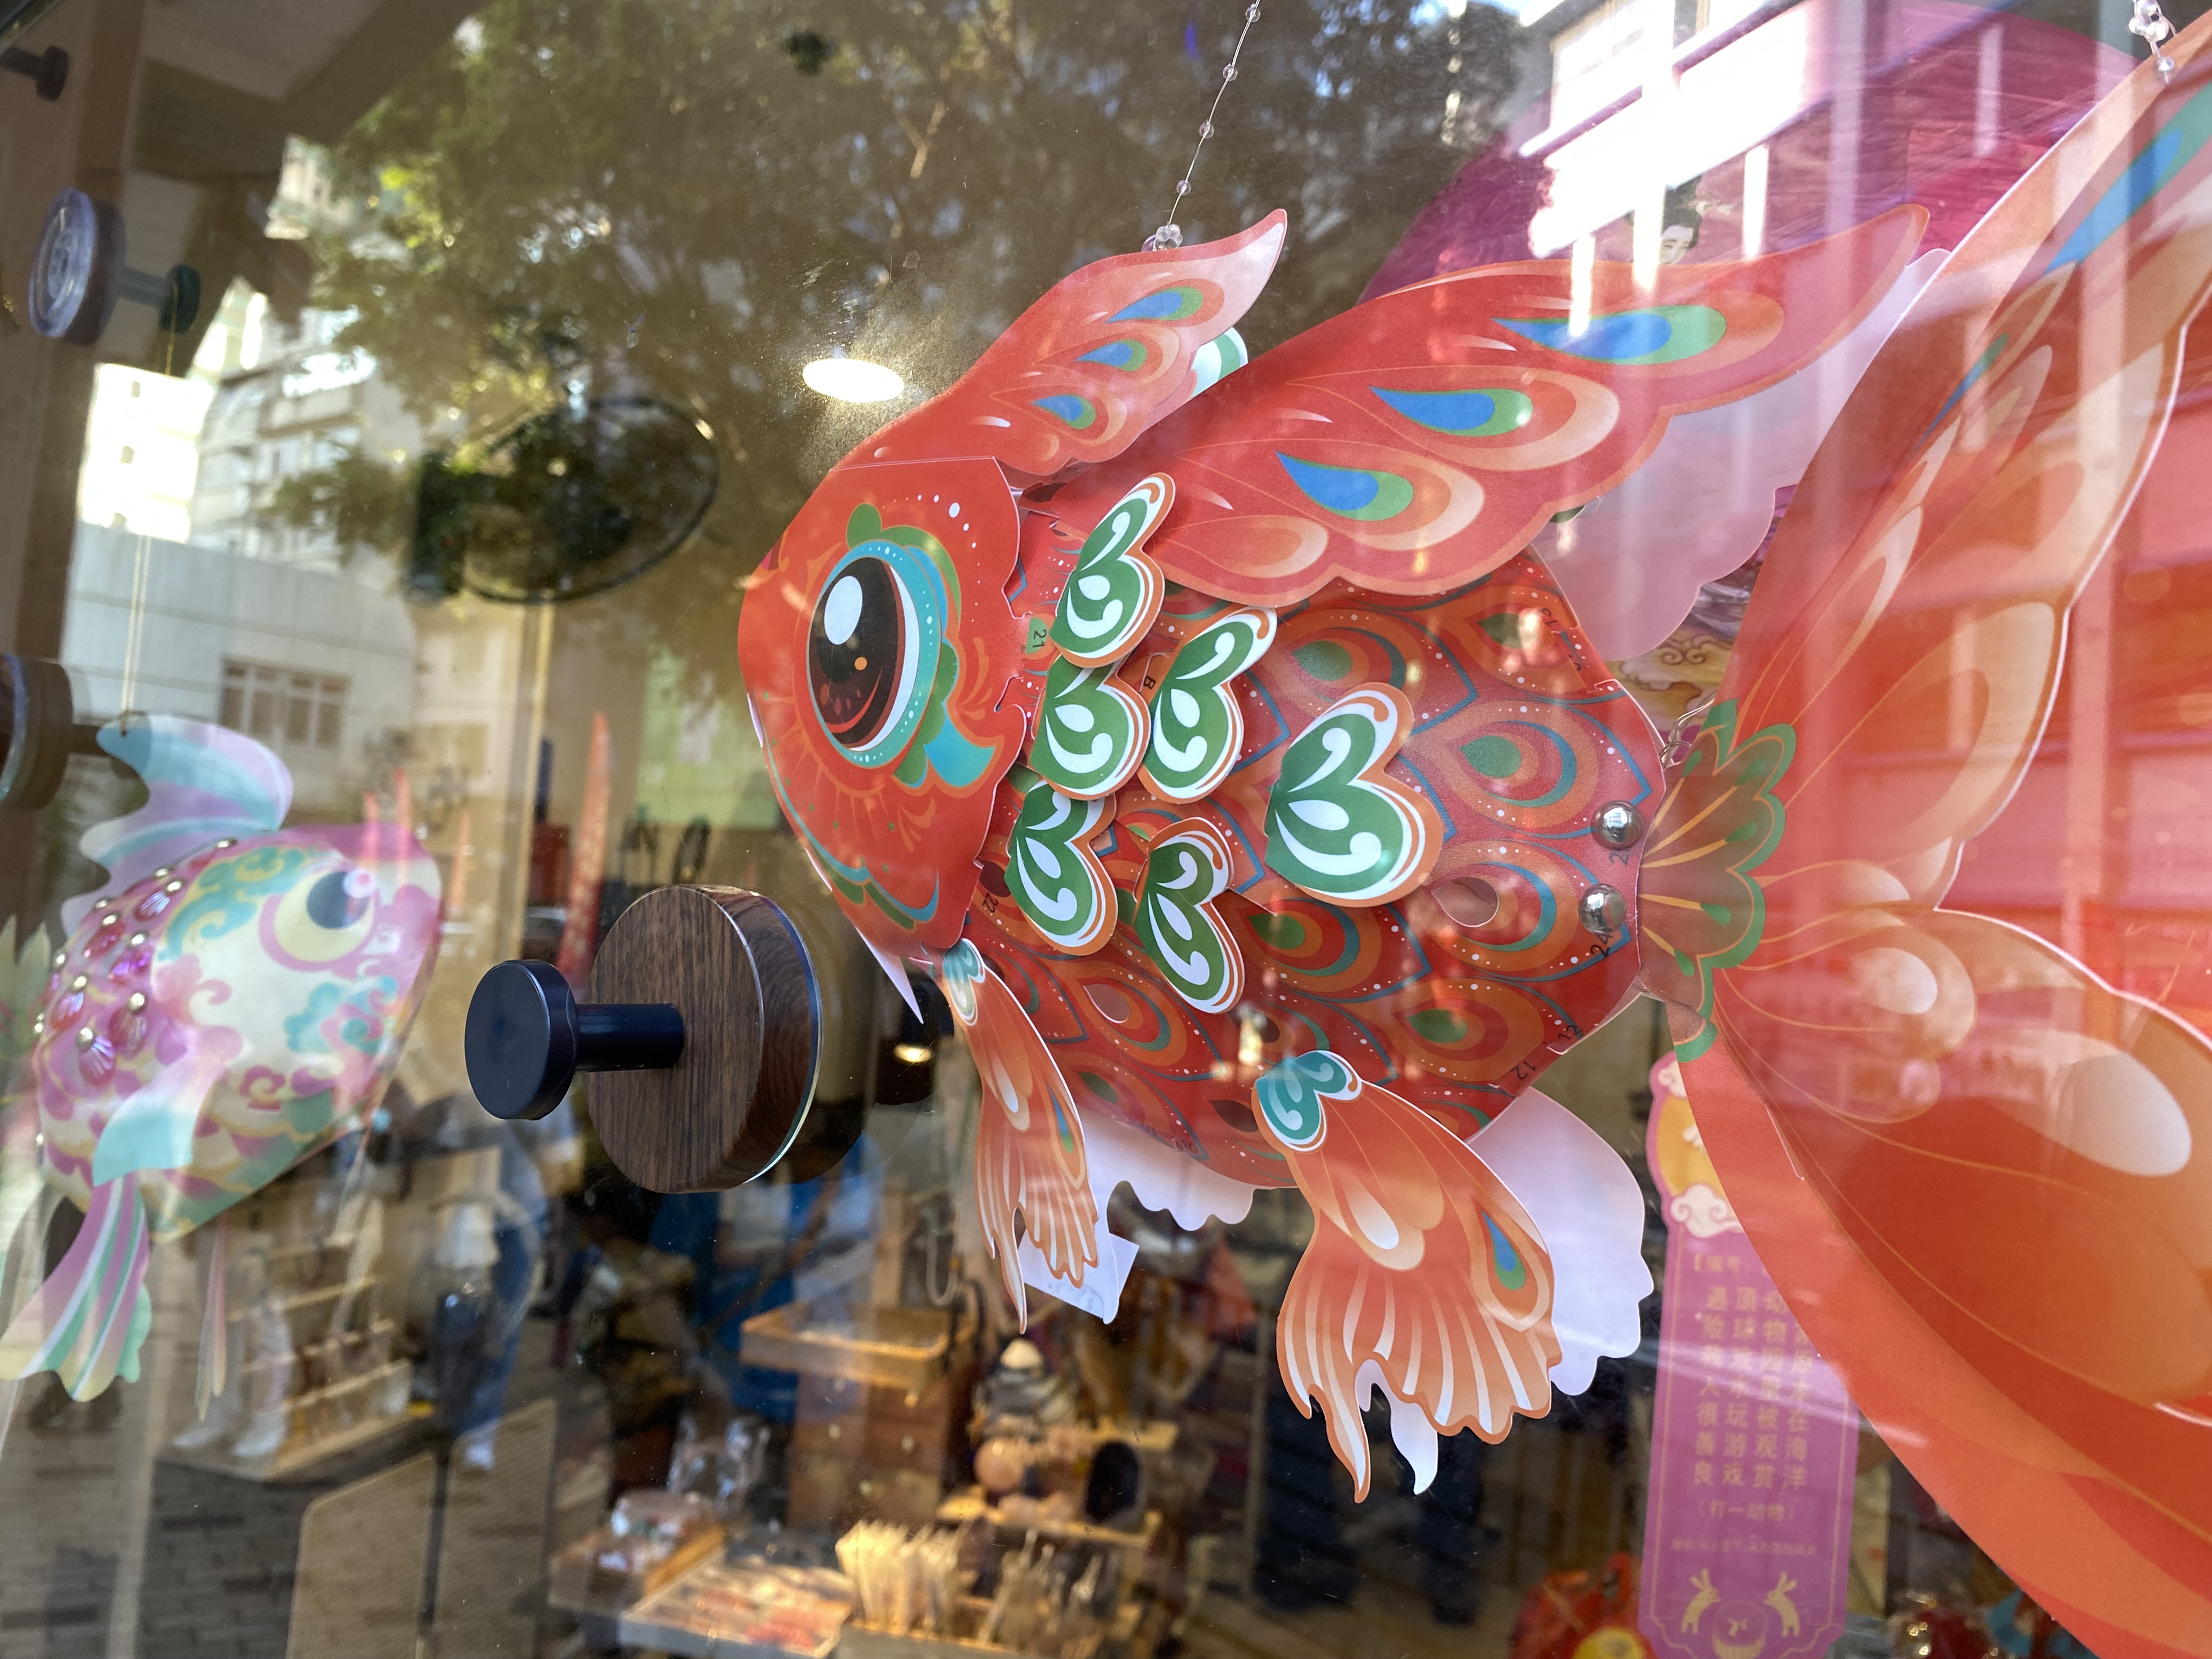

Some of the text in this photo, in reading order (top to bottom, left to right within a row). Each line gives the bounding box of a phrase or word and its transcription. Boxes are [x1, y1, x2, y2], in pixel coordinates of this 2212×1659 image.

[1032, 629, 1046, 648] 21
[1143, 675, 1156, 689] B
[982, 893, 998, 913] 22
[1590, 933, 1613, 958] 24
[1558, 1025, 1583, 1040] 12
[1510, 1061, 1536, 1080] 12
